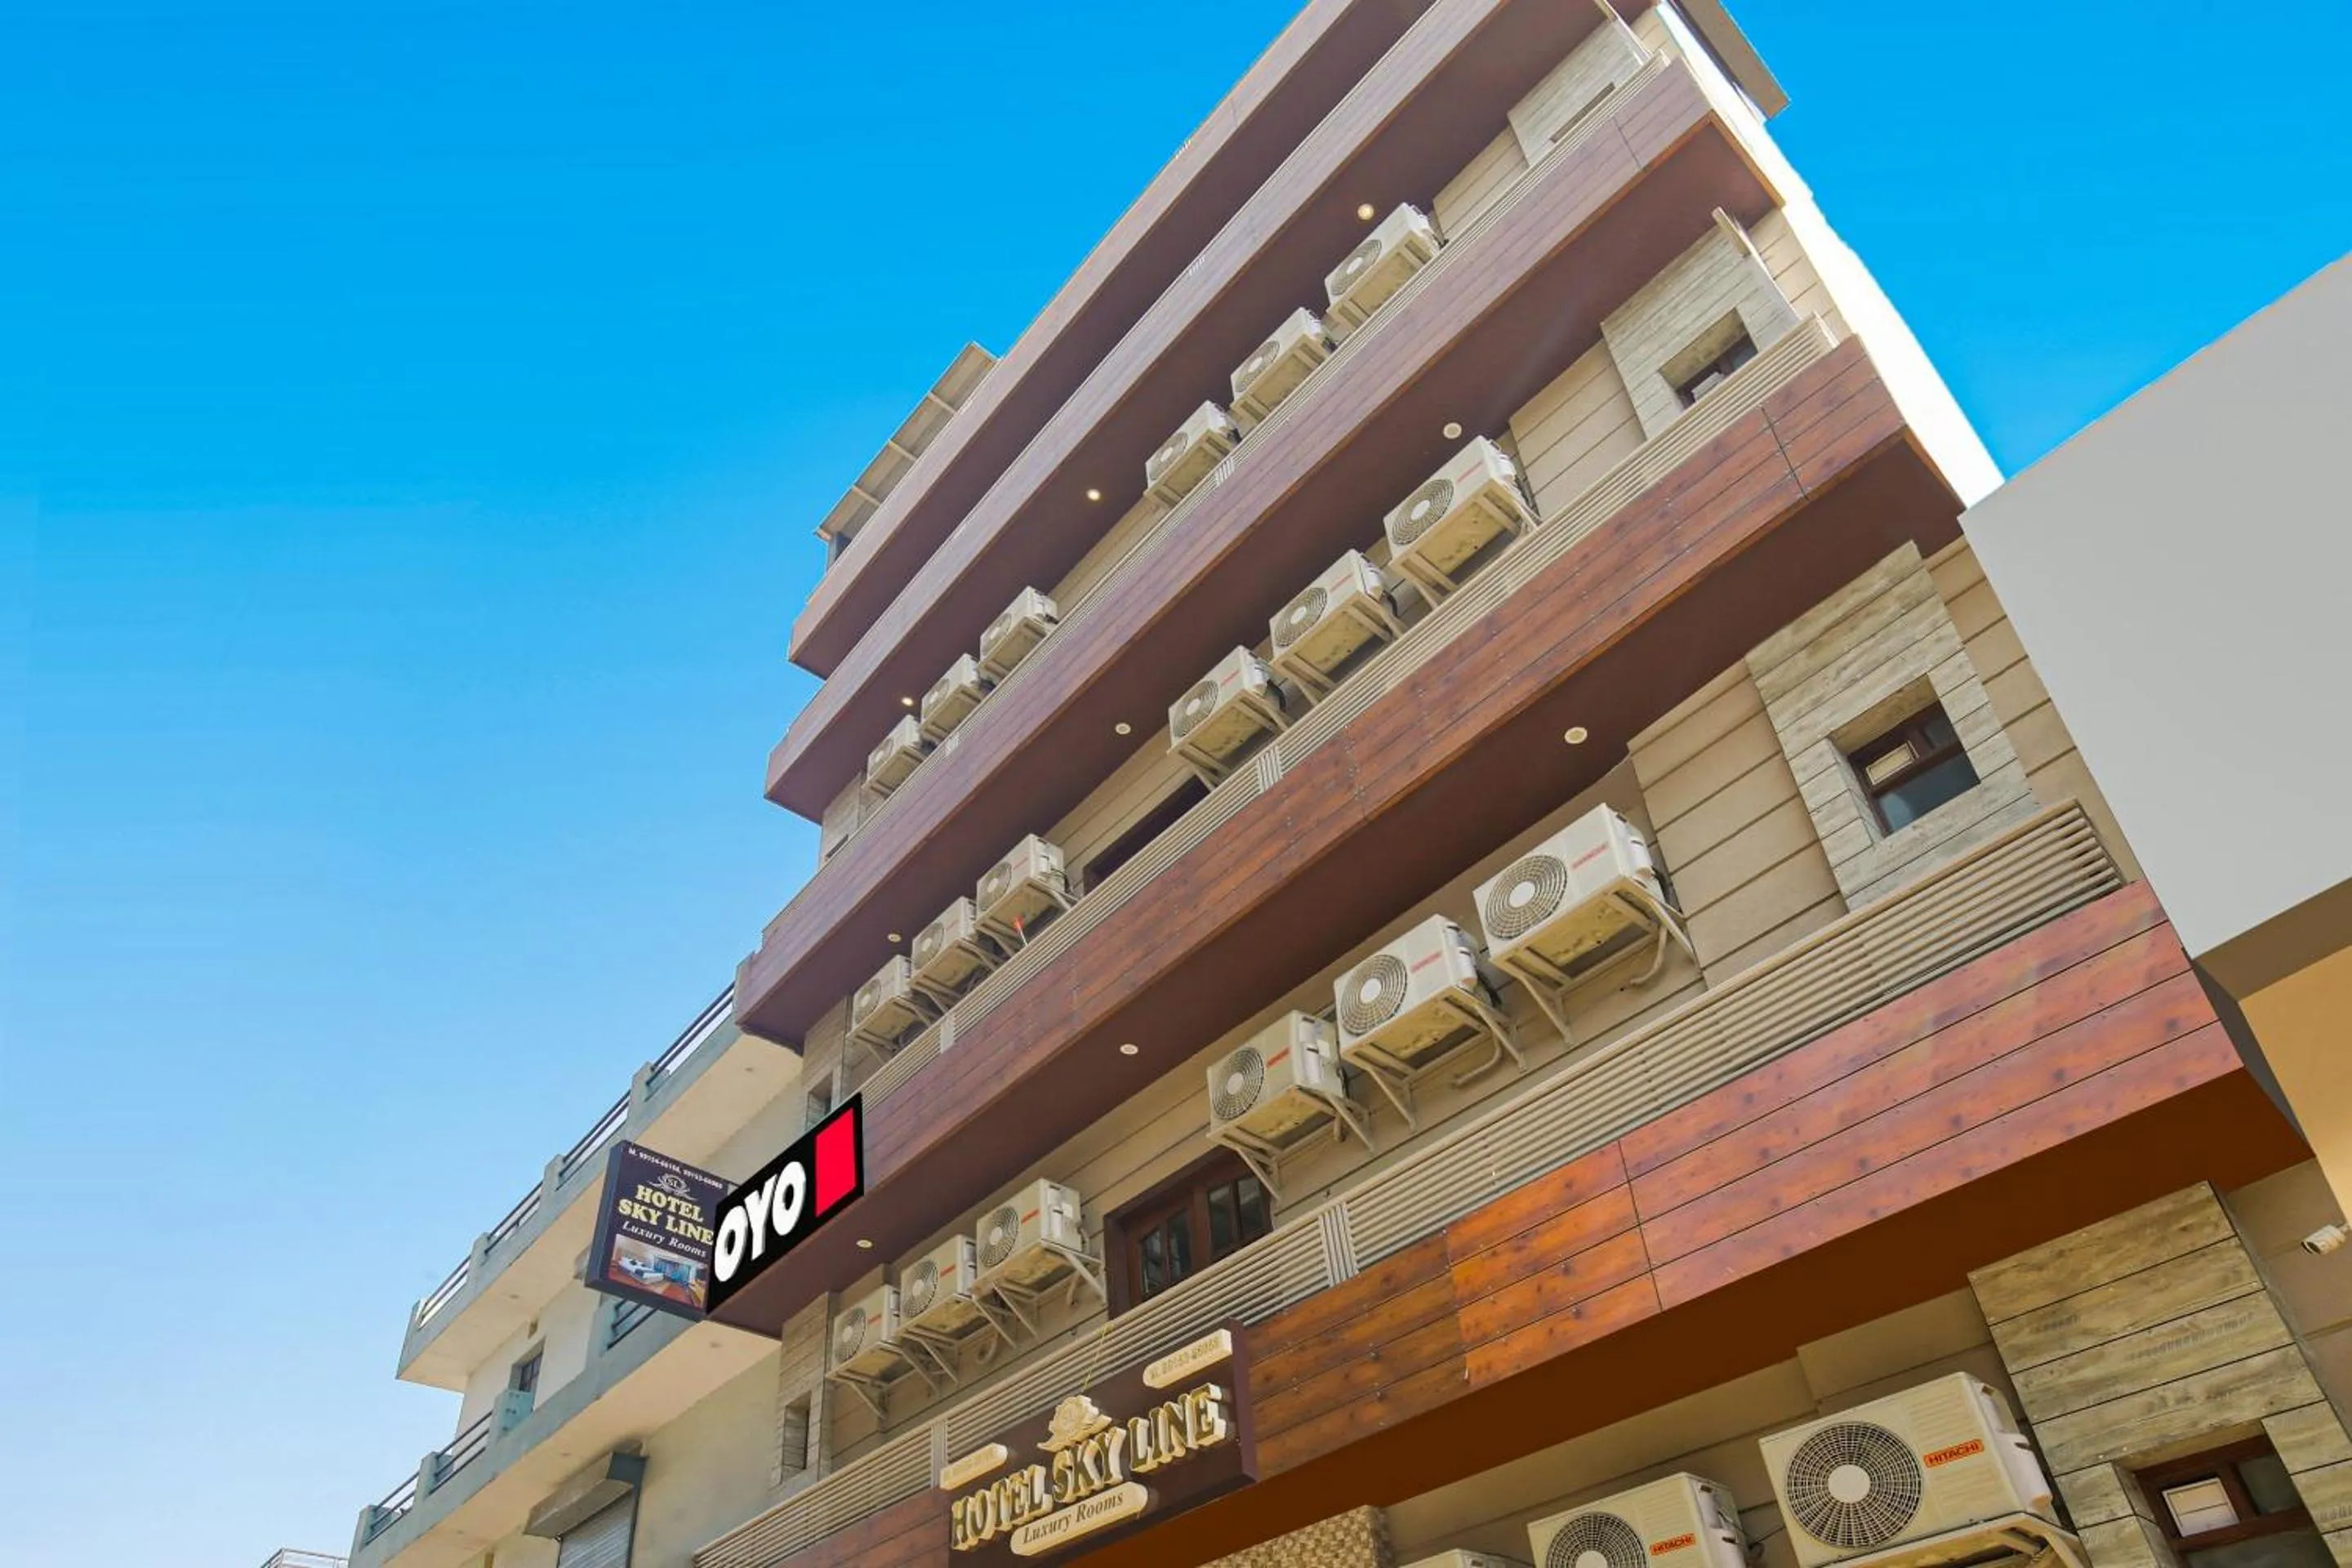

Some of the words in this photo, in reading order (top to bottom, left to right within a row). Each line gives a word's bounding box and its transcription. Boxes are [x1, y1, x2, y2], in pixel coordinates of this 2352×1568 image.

[618, 1199, 662, 1226] SKY
[666, 1214, 714, 1245] LINE
[635, 1184, 704, 1222] HOTEL
[714, 1160, 807, 1282] OYO
[622, 1221, 666, 1244] Luxury
[669, 1236, 706, 1258] Rooms
[951, 1464, 1054, 1551] HOTEL
[1053, 1426, 1127, 1503] SKY
[1128, 1382, 1227, 1472] LINE
[1927, 1441, 1981, 1465] HITACHI
[1023, 1512, 1071, 1544] Luxury
[1076, 1490, 1125, 1521] Rooms
[1651, 1535, 1695, 1554] HITACHI
